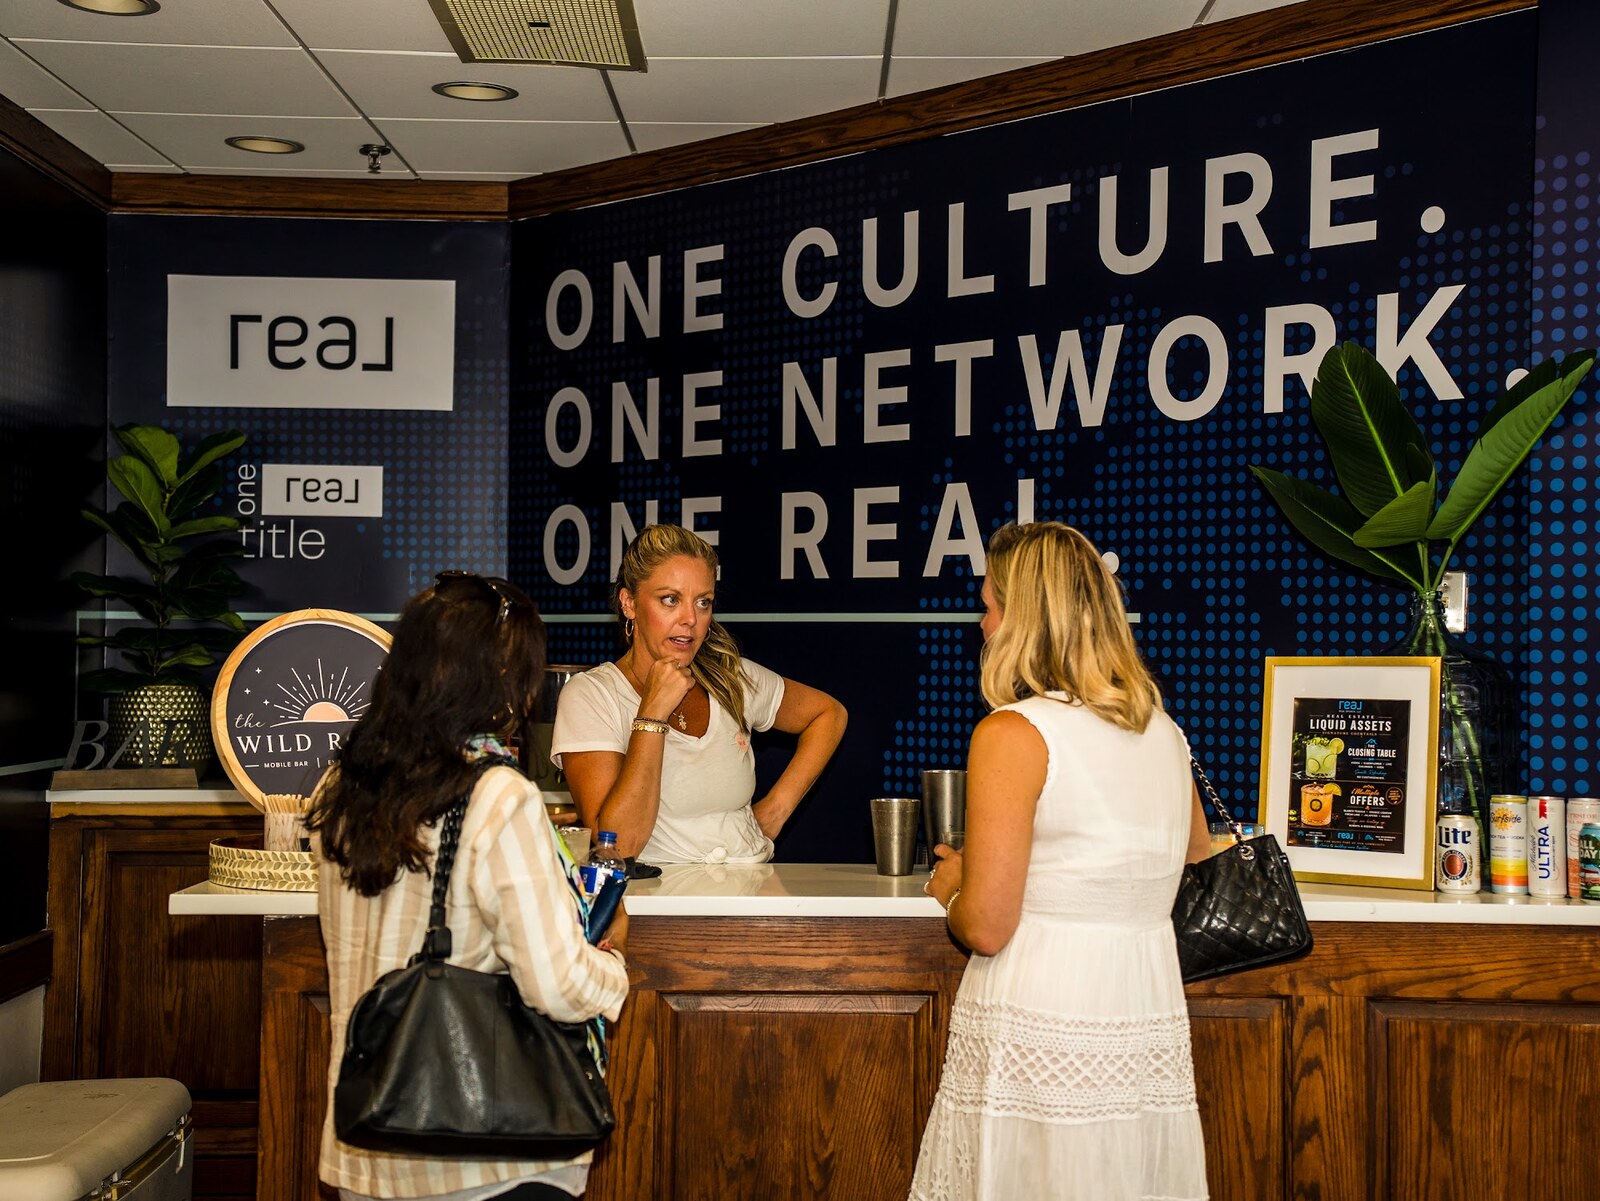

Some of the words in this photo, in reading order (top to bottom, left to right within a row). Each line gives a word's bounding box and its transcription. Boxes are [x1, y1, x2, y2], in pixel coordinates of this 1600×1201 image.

[545, 243, 725, 351] ONE
[781, 128, 1446, 319] CULTURE.
[544, 370, 724, 468] ONE
[237, 464, 256, 515] one
[237, 519, 326, 560] title
[234, 712, 266, 729] the
[1309, 719, 1347, 731] LIQUID
[1350, 720, 1392, 732] ASSETS
[236, 733, 312, 754] WILD
[1347, 747, 1376, 758] CLOSING
[1376, 749, 1397, 759] TABLE
[1350, 795, 1385, 807] OFFERS
[1438, 825, 1472, 849] Lite
[1537, 826, 1550, 879] ULTRA
